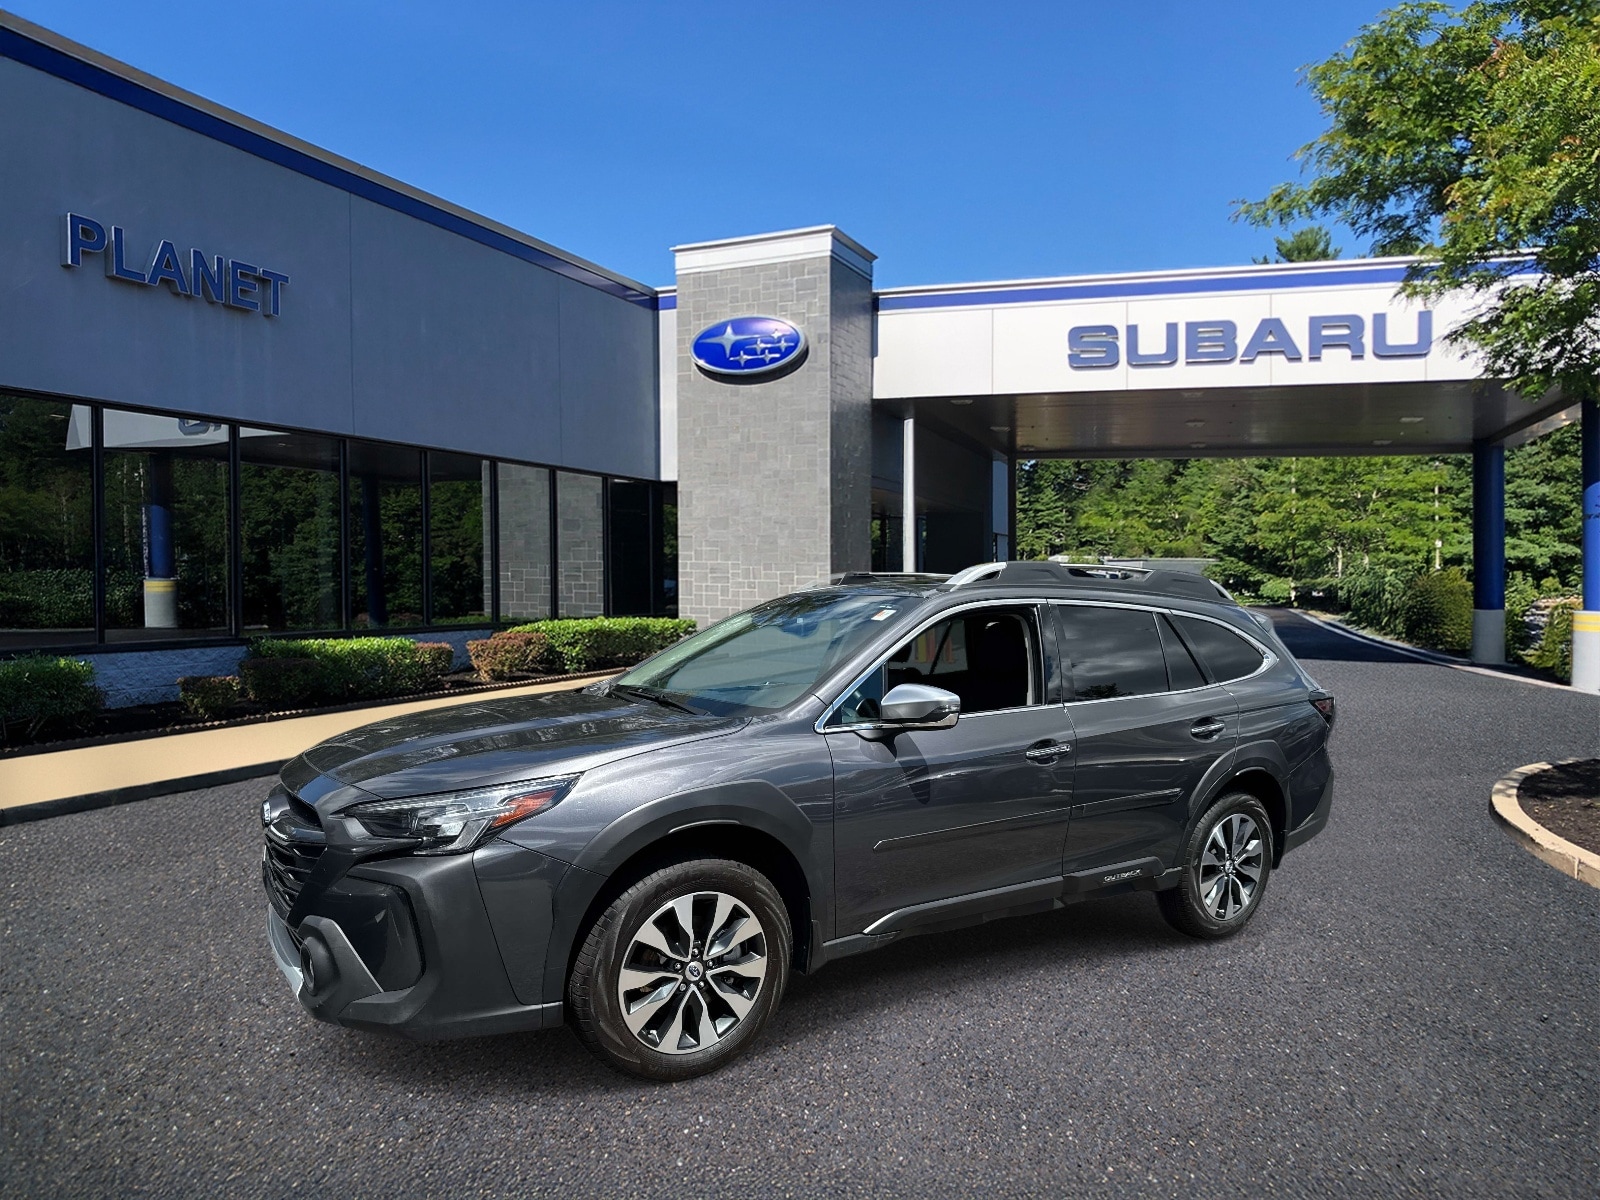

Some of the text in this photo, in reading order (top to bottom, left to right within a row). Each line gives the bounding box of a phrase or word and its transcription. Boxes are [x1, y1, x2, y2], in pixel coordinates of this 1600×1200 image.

[64, 212, 290, 317] PLANET
[1067, 310, 1433, 369] SUBARU
[1103, 869, 1142, 882] OUTBACK
